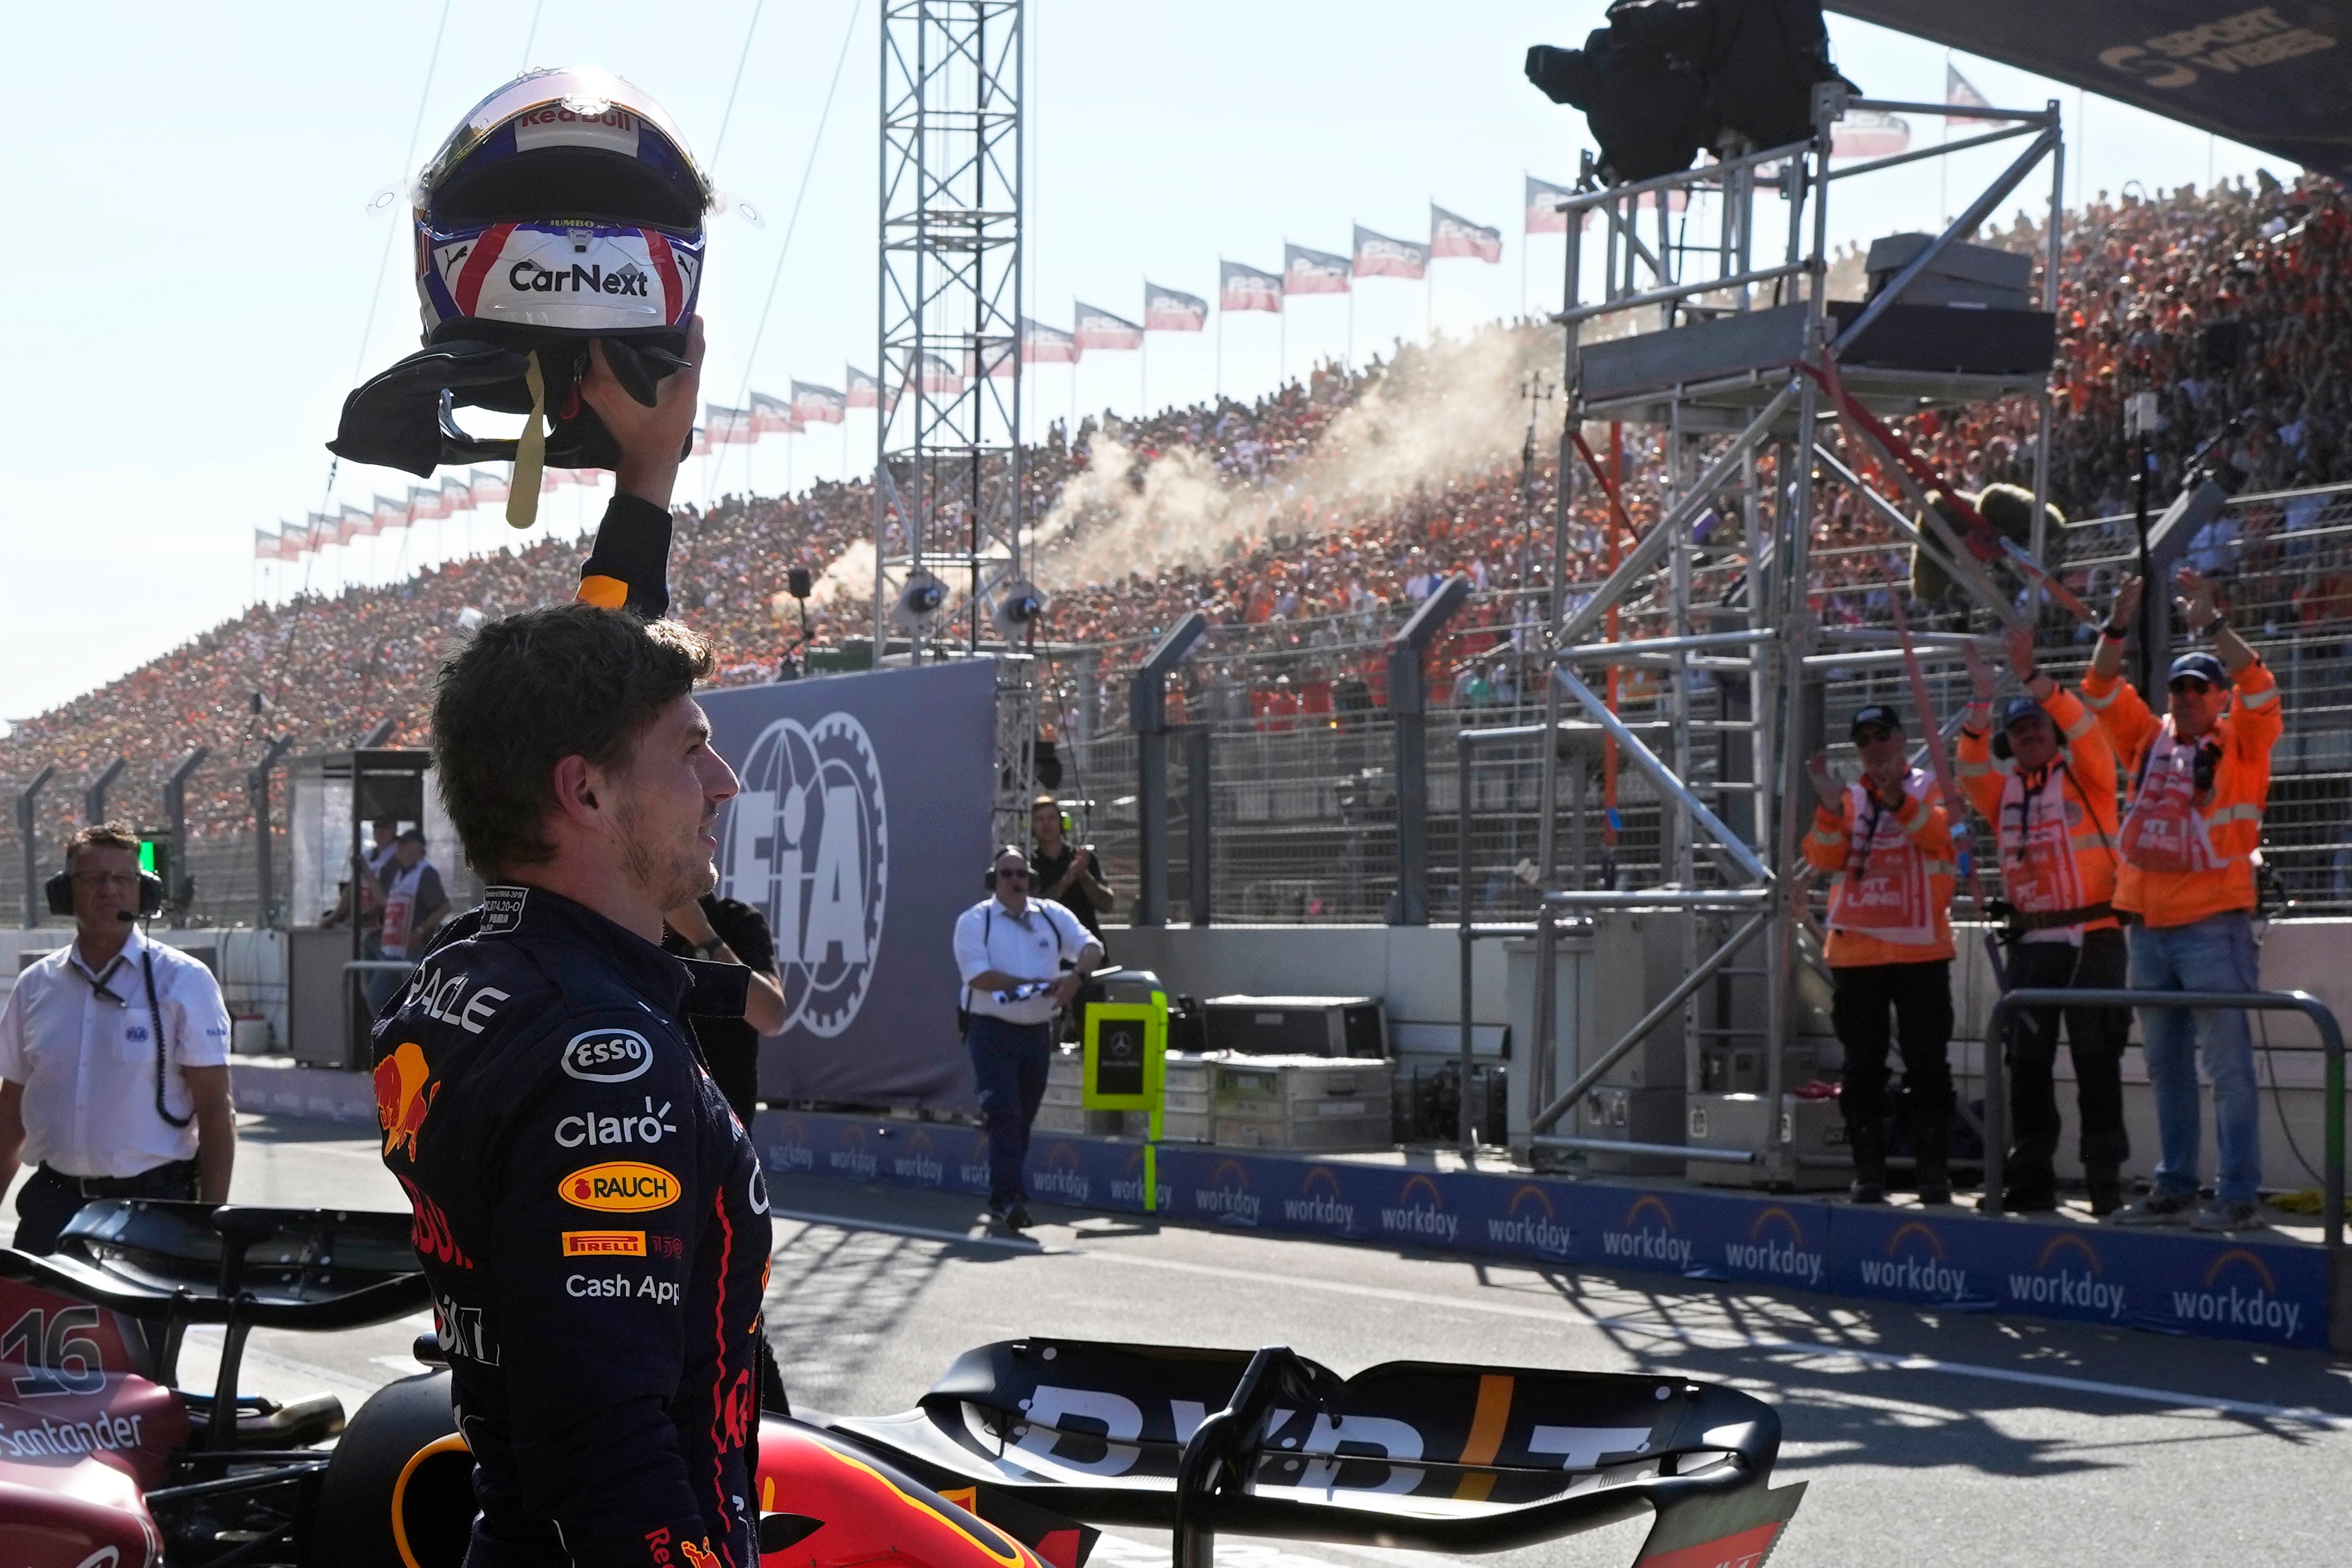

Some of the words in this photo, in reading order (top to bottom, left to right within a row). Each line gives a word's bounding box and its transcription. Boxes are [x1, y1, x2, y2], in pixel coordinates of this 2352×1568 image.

[509, 261, 647, 297] CarNext
[405, 961, 511, 1034] RACLE
[554, 1111, 662, 1148] Claro
[594, 1177, 668, 1198] RAUCH
[1284, 1194, 1354, 1232] workday
[1382, 1203, 1459, 1242] workday
[570, 1235, 639, 1252] PIRELLI
[1487, 1214, 1571, 1255] workday
[1603, 1227, 1692, 1269] workday
[1726, 1239, 1822, 1285] workday
[1860, 1255, 1966, 1301] workday
[566, 1273, 631, 1297] Cash
[2010, 1269, 2119, 1319] workday
[2172, 1286, 2300, 1340] workday
[1, 1305, 106, 1398] 16
[0, 1410, 141, 1458] Santander
[645, 1527, 675, 1568] Re
